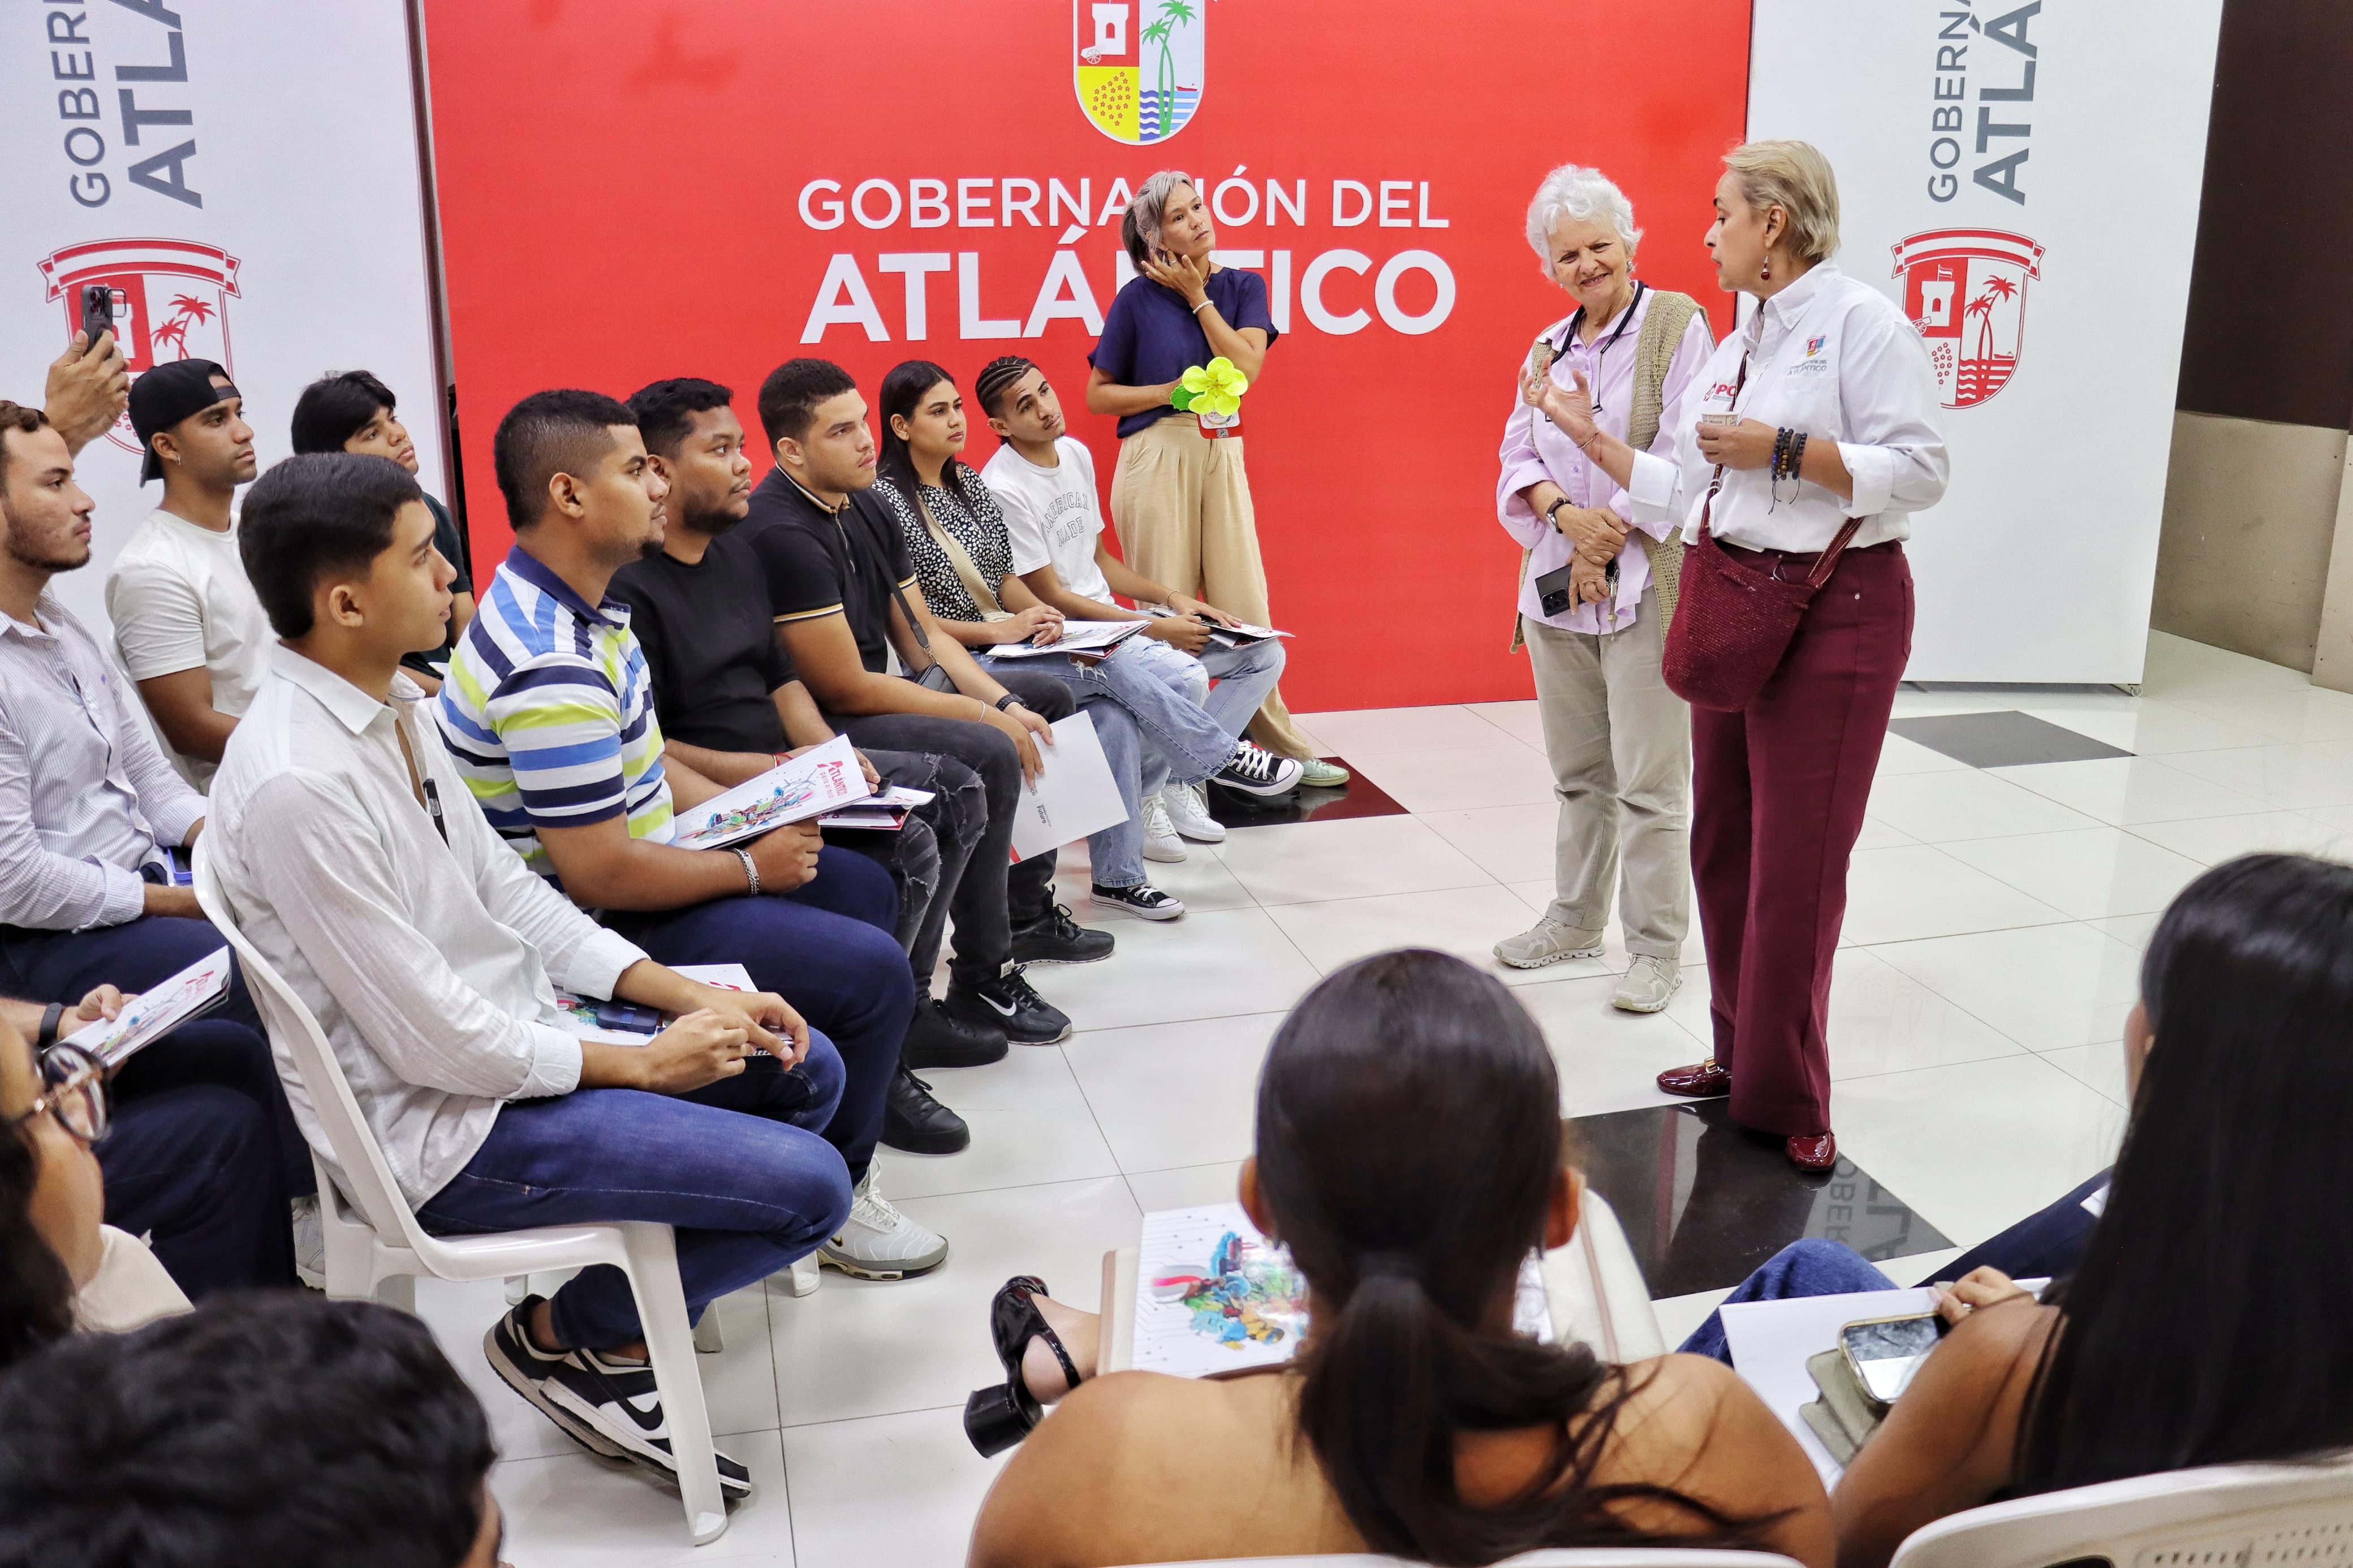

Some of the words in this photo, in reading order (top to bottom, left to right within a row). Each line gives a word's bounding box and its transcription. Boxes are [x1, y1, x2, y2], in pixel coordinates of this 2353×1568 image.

[43, 0, 110, 208] GOBER
[1927, 0, 1971, 203] GOBERN
[798, 165, 1306, 231] GOBERNAÓN
[1332, 179, 1449, 228] DEL
[799, 224, 1456, 344] ATLÁICO
[1036, 805, 1046, 824] Futuro
